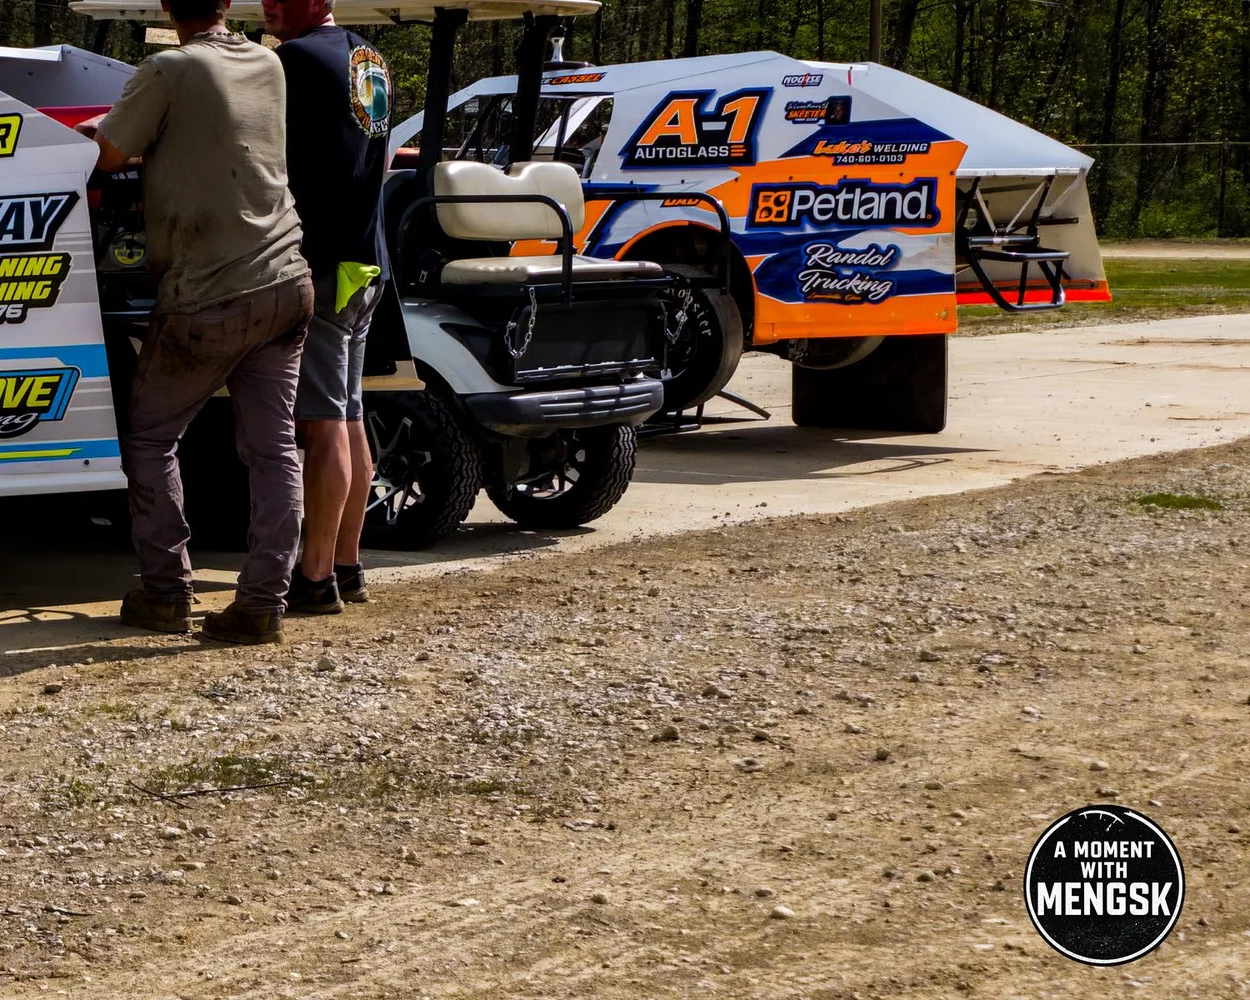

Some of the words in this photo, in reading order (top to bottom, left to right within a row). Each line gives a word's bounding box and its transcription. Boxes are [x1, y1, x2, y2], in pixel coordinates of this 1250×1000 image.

[551, 74, 603, 85] CASSEL
[636, 96, 760, 146] A-1
[634, 146, 729, 159] AUTOGLASS
[813, 139, 873, 155] Luke's
[873, 143, 928, 153] WELDING
[791, 185, 928, 221] Petland
[806, 243, 895, 266] Randol
[798, 269, 893, 301] Trucking
